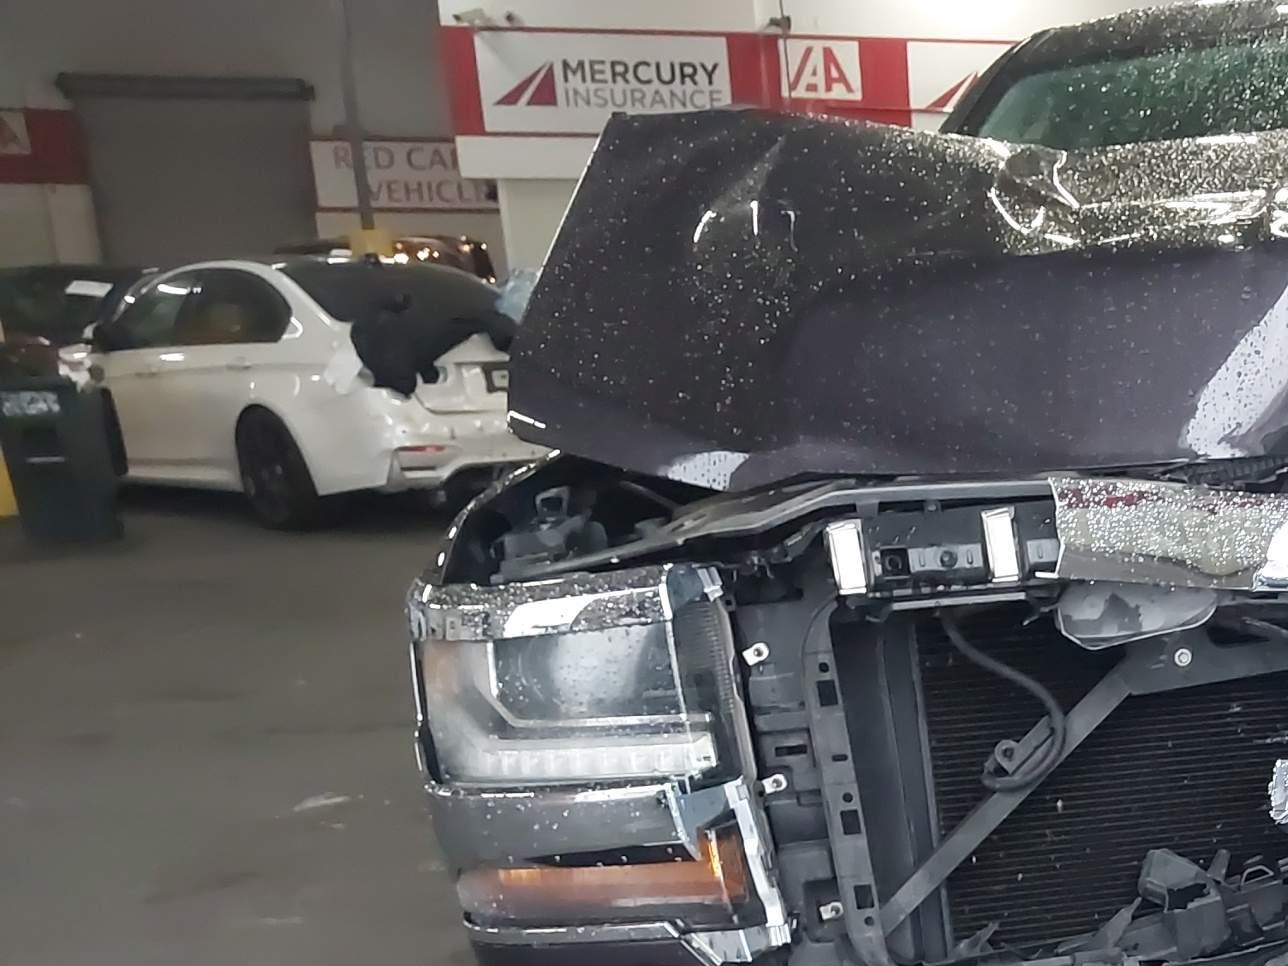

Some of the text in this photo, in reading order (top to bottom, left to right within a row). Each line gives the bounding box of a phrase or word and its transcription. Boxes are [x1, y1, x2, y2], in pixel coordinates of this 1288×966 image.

[561, 59, 719, 86] MERCURY
[563, 87, 723, 109] INSURANCE
[332, 145, 395, 170] RD
